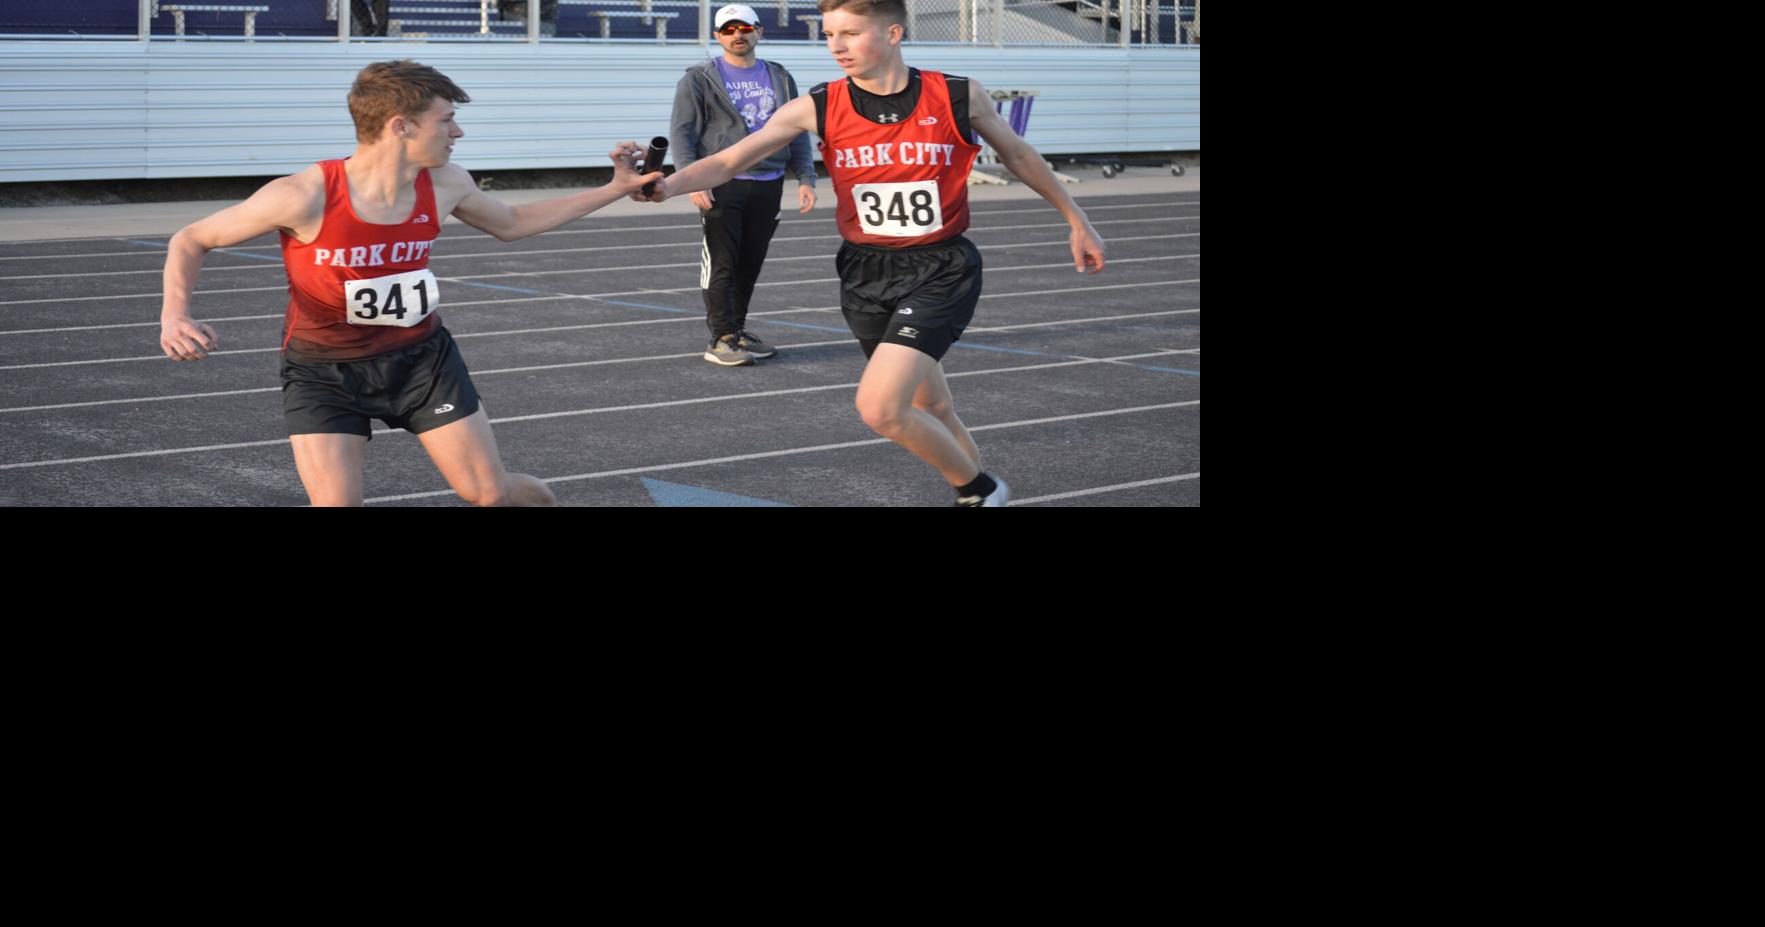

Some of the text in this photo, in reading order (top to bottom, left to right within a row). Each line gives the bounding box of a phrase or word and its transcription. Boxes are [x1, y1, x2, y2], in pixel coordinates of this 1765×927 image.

[725, 81, 762, 90] AUREL
[835, 142, 955, 168] PARK CITY
[861, 189, 935, 227] 348
[314, 244, 386, 267] PARK
[354, 279, 429, 320] 341
